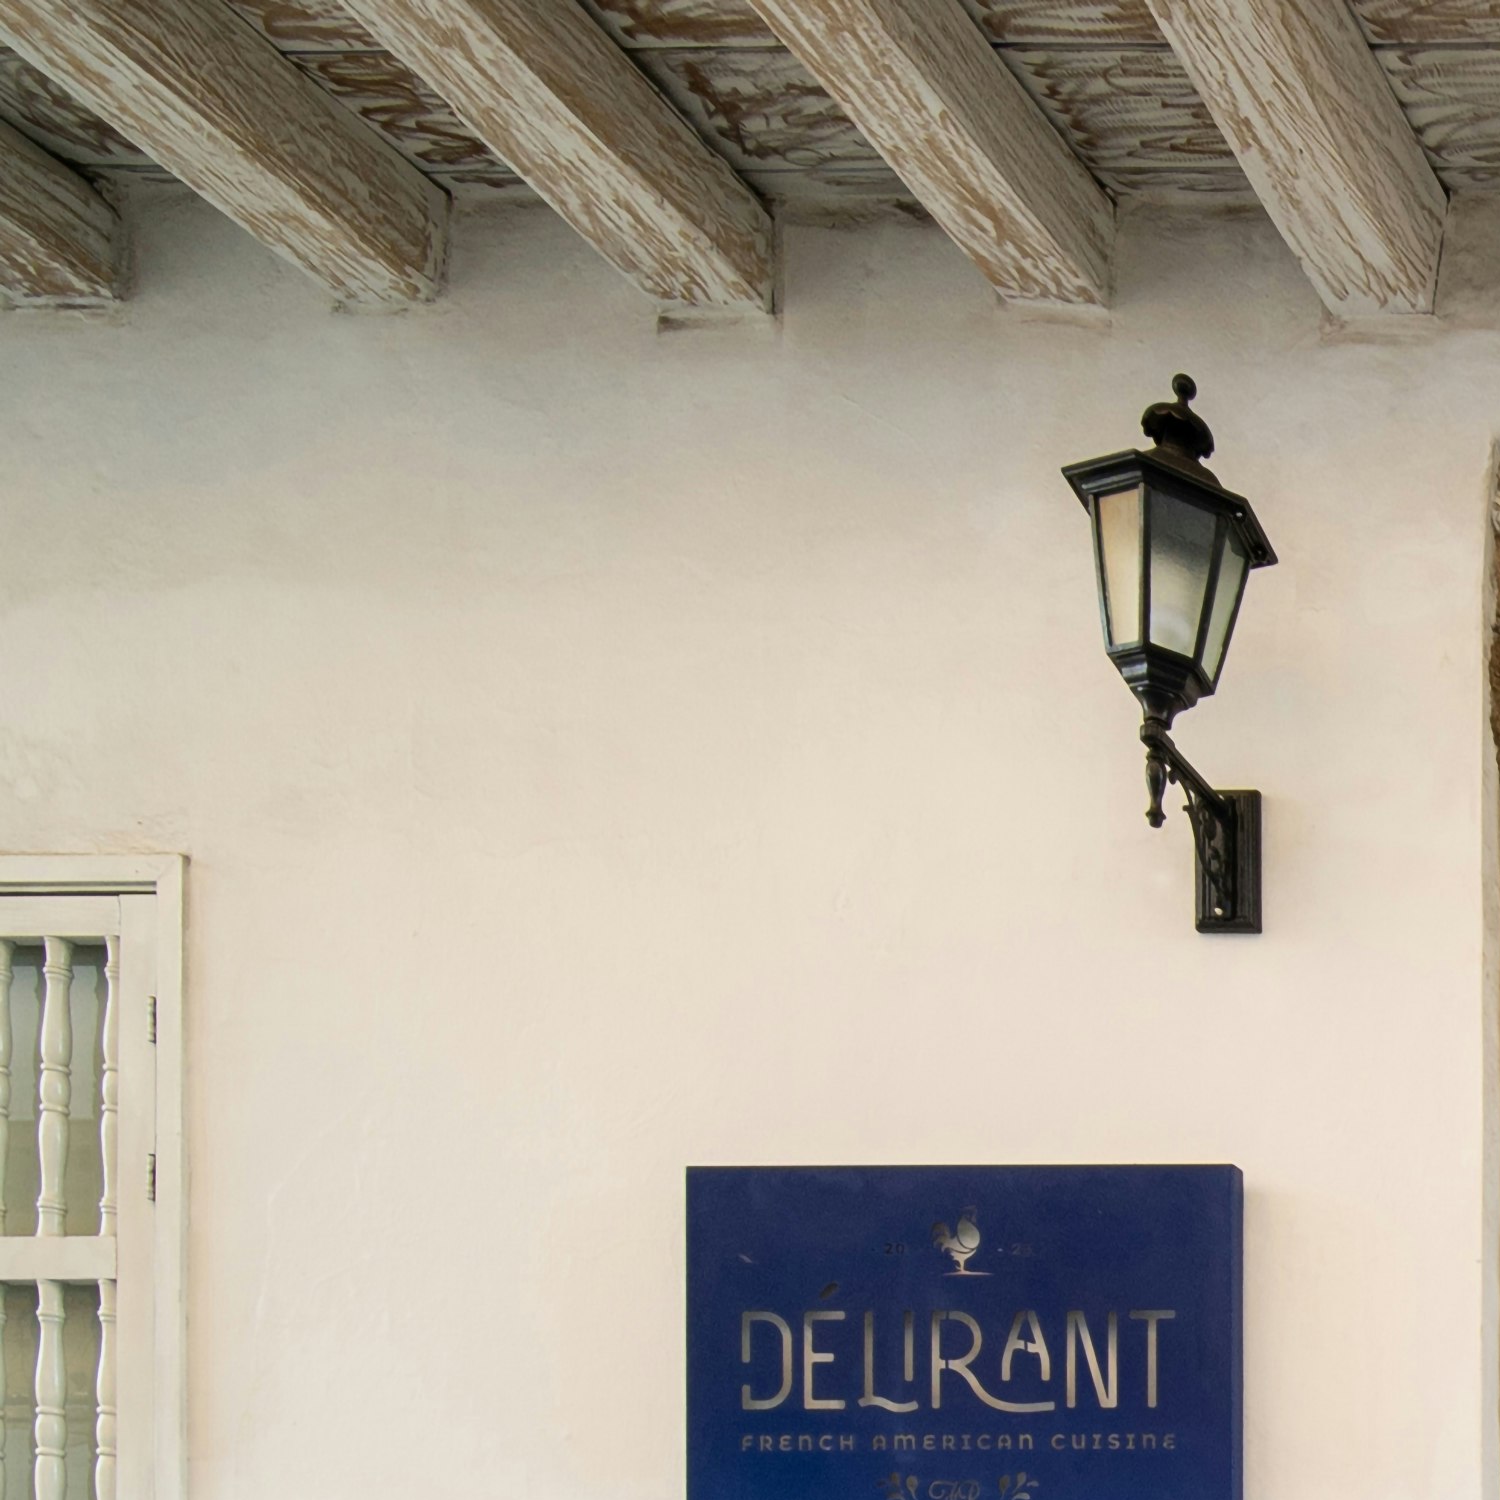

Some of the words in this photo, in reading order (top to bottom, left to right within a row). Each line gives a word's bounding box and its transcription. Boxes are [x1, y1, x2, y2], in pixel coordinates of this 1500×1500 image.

[884, 1242, 905, 1255] 20
[741, 1282, 1176, 1413] DÉLIRANT
[741, 1433, 855, 1453] FRENCH
[872, 1432, 1035, 1452] AMERICAN
[1050, 1432, 1177, 1451] CUISINE
